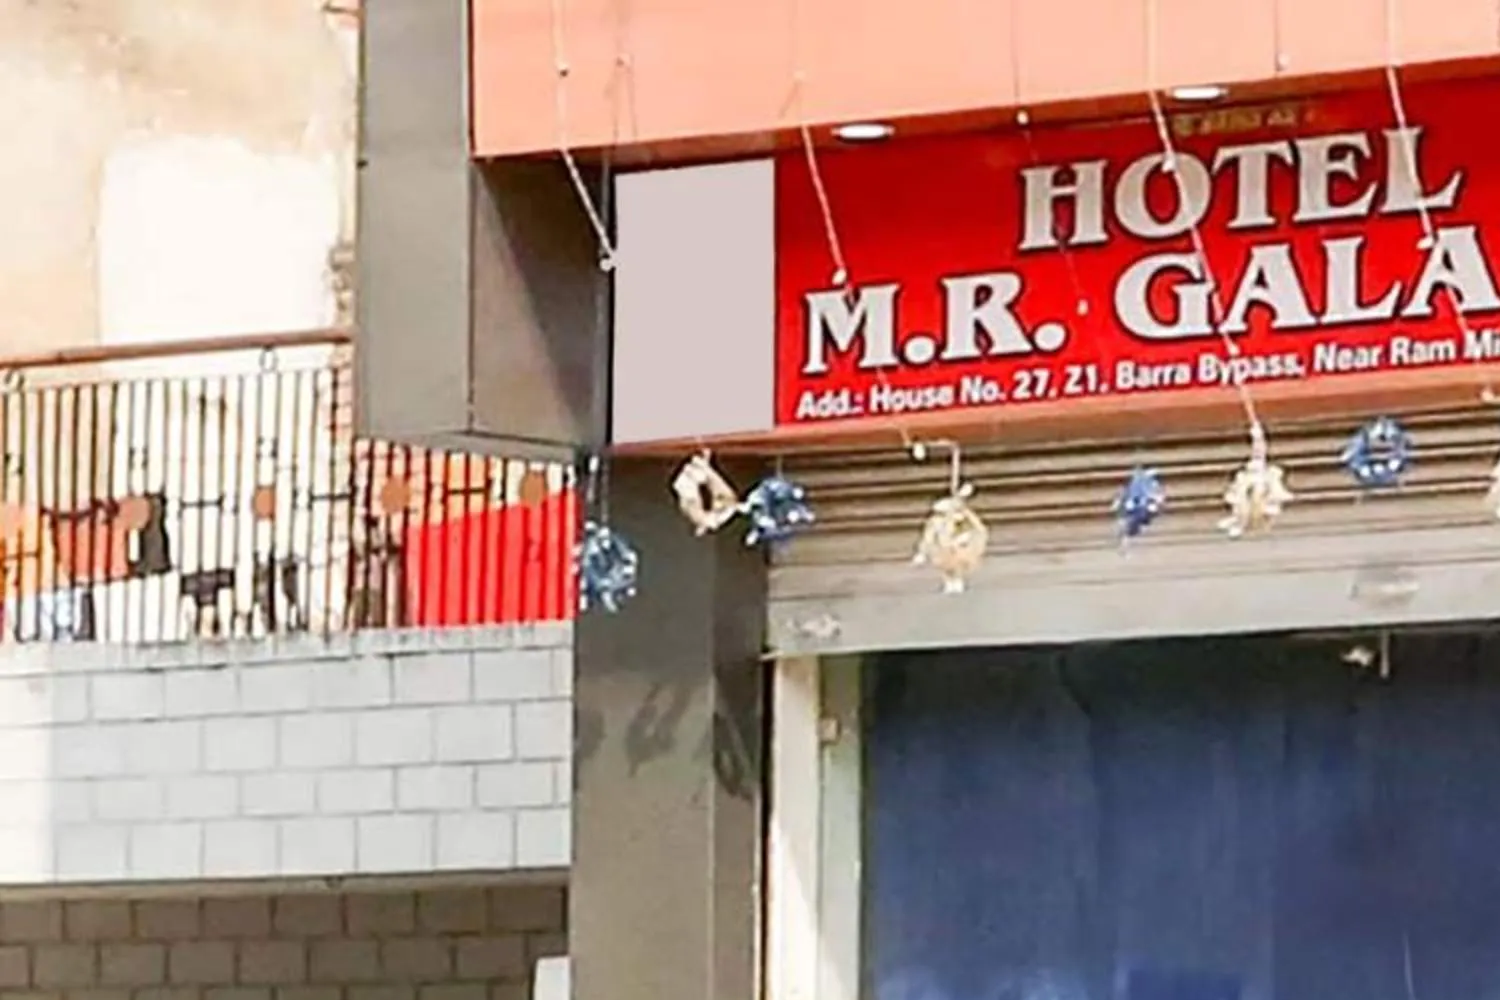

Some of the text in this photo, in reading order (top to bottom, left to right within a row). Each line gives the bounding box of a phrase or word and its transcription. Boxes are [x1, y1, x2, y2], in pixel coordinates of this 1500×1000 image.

[1018, 126, 1464, 254] HOTEL
[803, 271, 1066, 373] M.R.
[869, 384, 954, 412] House
[960, 375, 1006, 404] No.
[1115, 360, 1191, 390] Barra
[1314, 342, 1384, 372] Near
[1390, 335, 1456, 365] Ram
